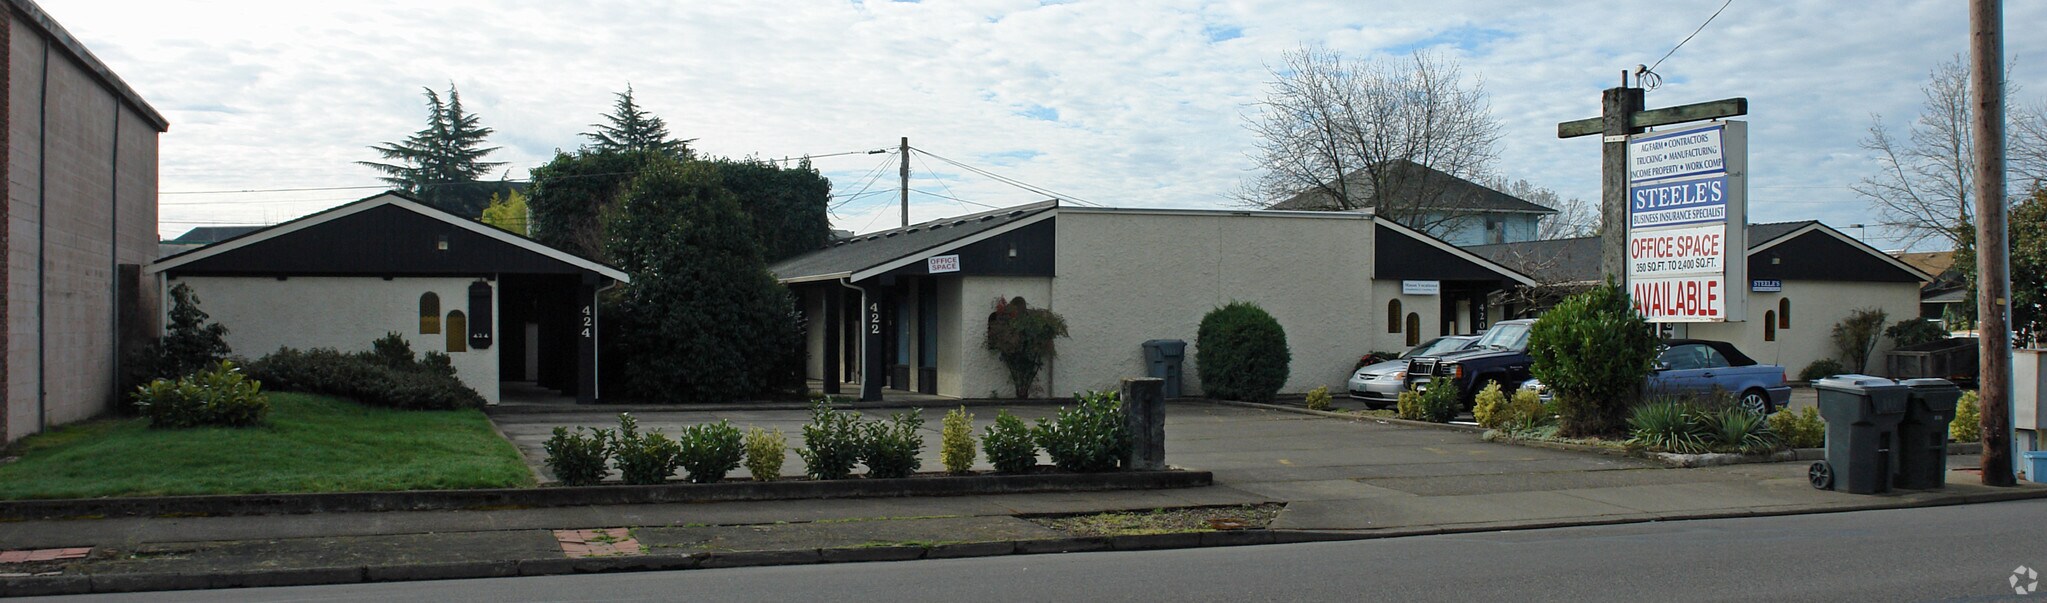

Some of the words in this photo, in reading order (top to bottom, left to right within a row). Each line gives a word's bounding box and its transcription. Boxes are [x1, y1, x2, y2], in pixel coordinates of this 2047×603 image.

[1641, 141, 1649, 153] AG
[1649, 138, 1663, 151] FARM
[1668, 133, 1709, 148] CONTRACTORS
[1636, 154, 1663, 166] TRUCKING
[1669, 145, 1717, 160] MANUFACTURING
[1652, 164, 1679, 176] PROPERTY
[1685, 160, 1704, 171] WORK
[1704, 157, 1722, 168] COMP
[1636, 180, 1722, 210] STEELE'S
[1633, 213, 1659, 225] BUSINESS
[1659, 209, 1692, 222] INSURANCE
[1692, 206, 1724, 220] SPECIALIST
[1631, 236, 1674, 259] OFFICE
[1676, 234, 1719, 258] SPACE
[930, 256, 958, 265] OFFICE
[931, 263, 957, 271] SPACE
[1636, 263, 1647, 273] 350
[1668, 260, 1677, 270] TO
[1677, 259, 1695, 271] 2,400
[1633, 280, 1718, 317] AVAILABLE
[582, 305, 592, 338] 424
[870, 302, 880, 334] 422
